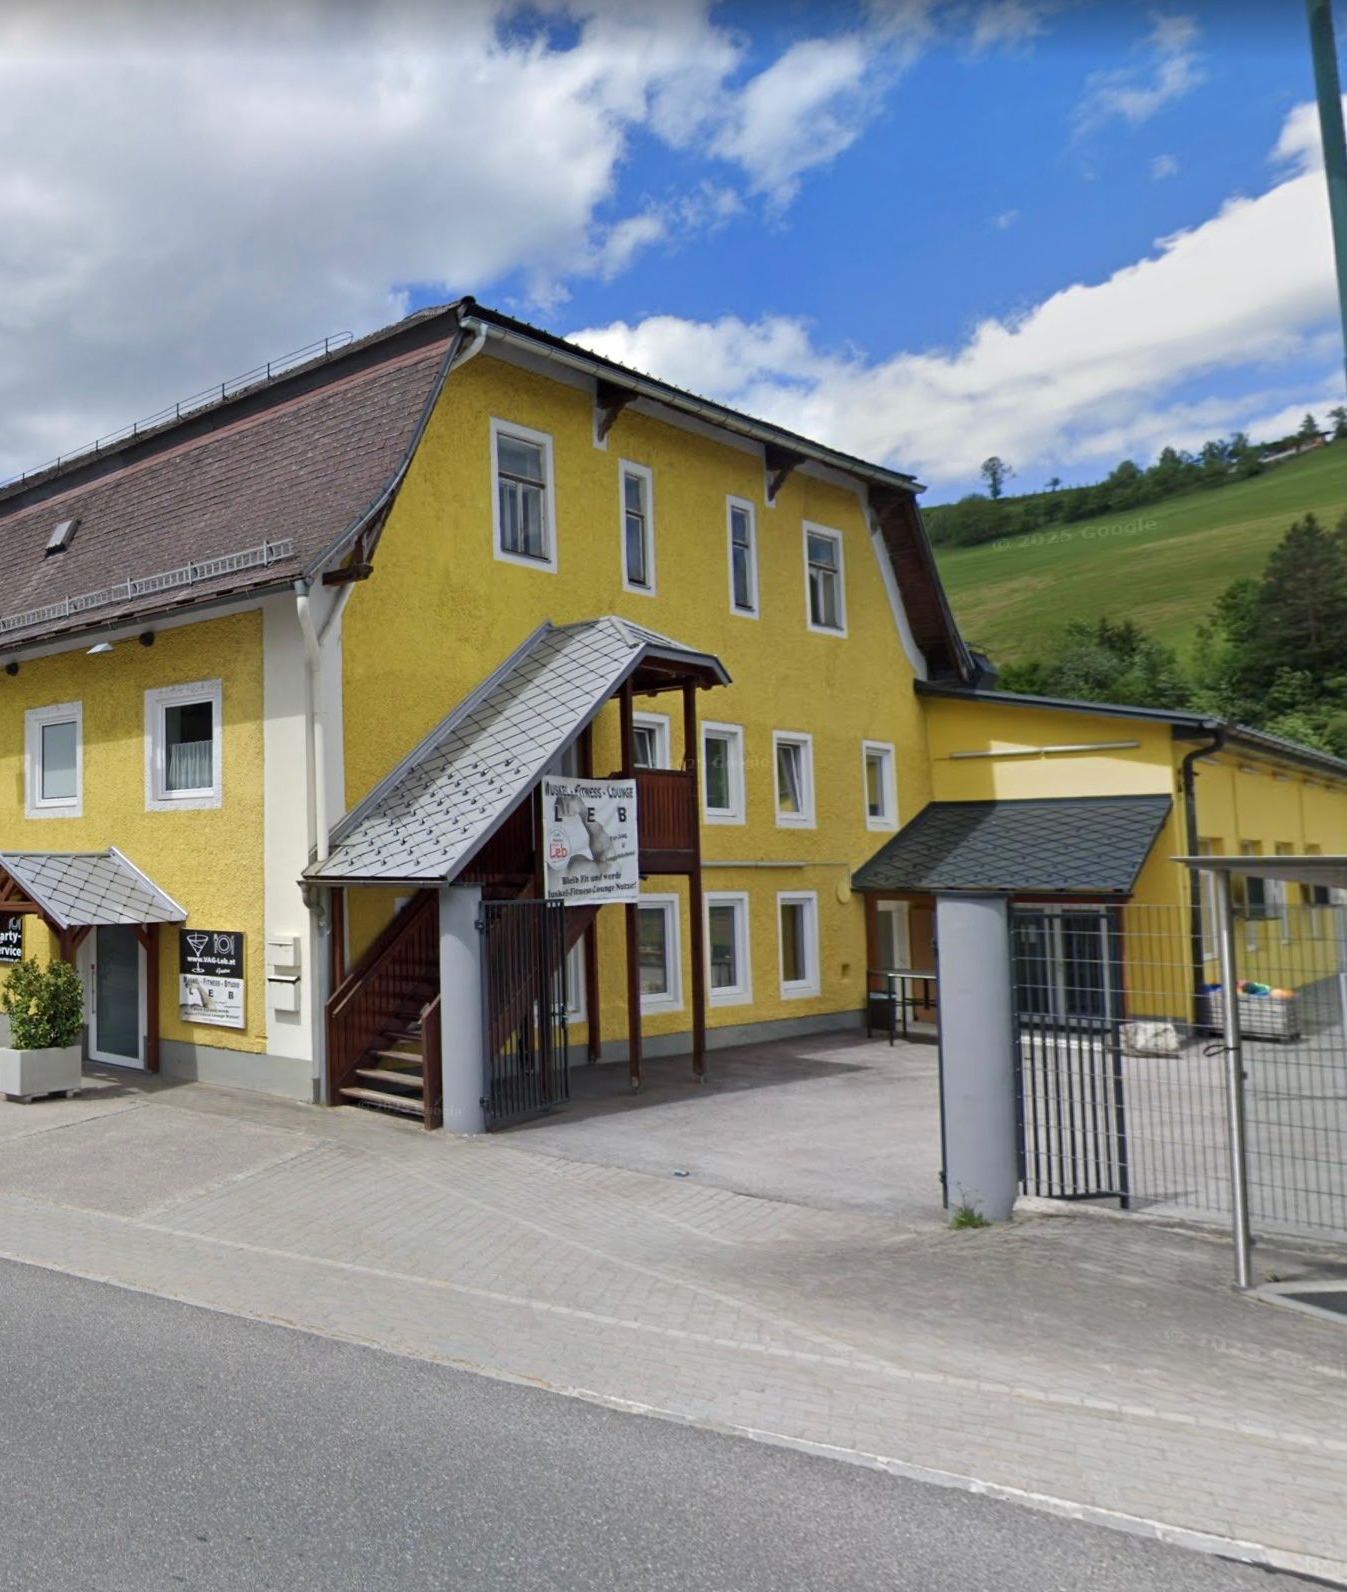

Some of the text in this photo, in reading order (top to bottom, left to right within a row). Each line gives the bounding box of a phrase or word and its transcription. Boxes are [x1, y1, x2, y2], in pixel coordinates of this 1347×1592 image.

[575, 784, 602, 799] FITNESS
[607, 785, 635, 799] LOUNGE
[550, 843, 568, 860] Leb
[580, 874, 589, 884] Fit
